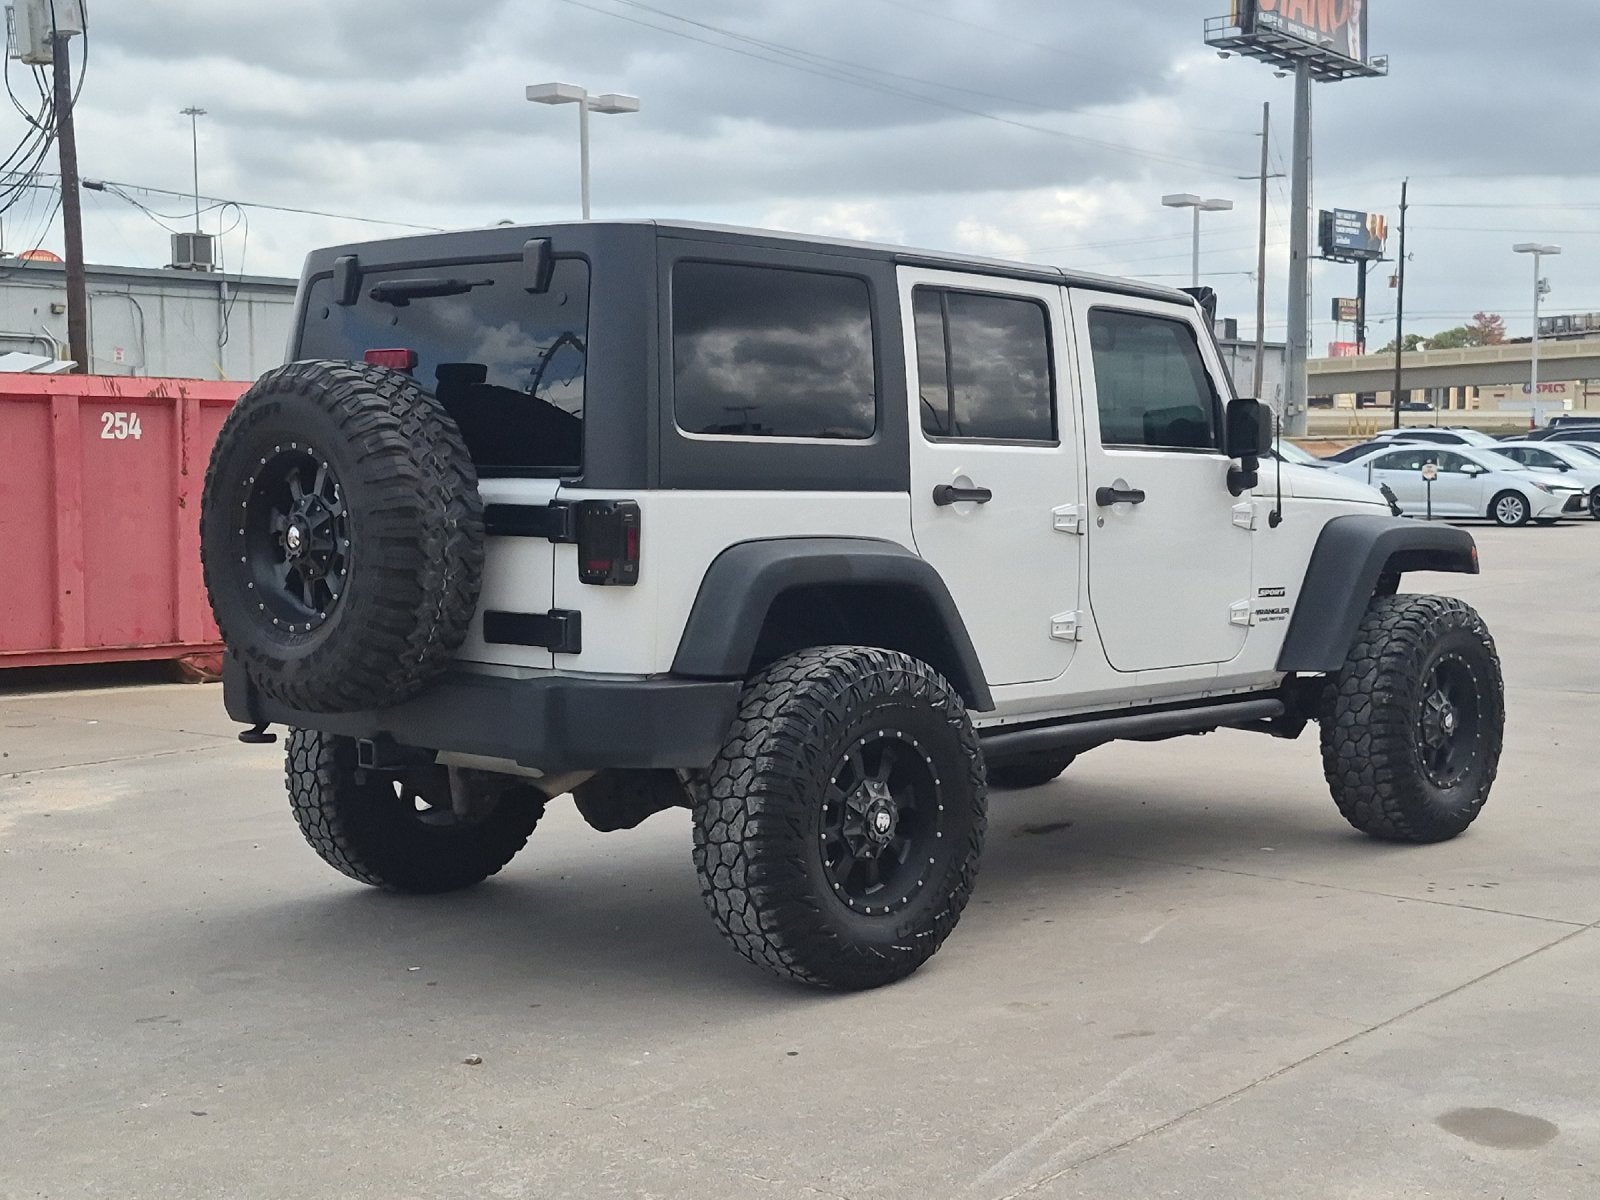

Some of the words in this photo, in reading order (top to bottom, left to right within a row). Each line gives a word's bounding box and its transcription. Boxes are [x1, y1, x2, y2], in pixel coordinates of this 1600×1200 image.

[101, 411, 142, 440] 254
[1258, 587, 1285, 597] SPORT
[1255, 607, 1290, 615] WRANGLER
